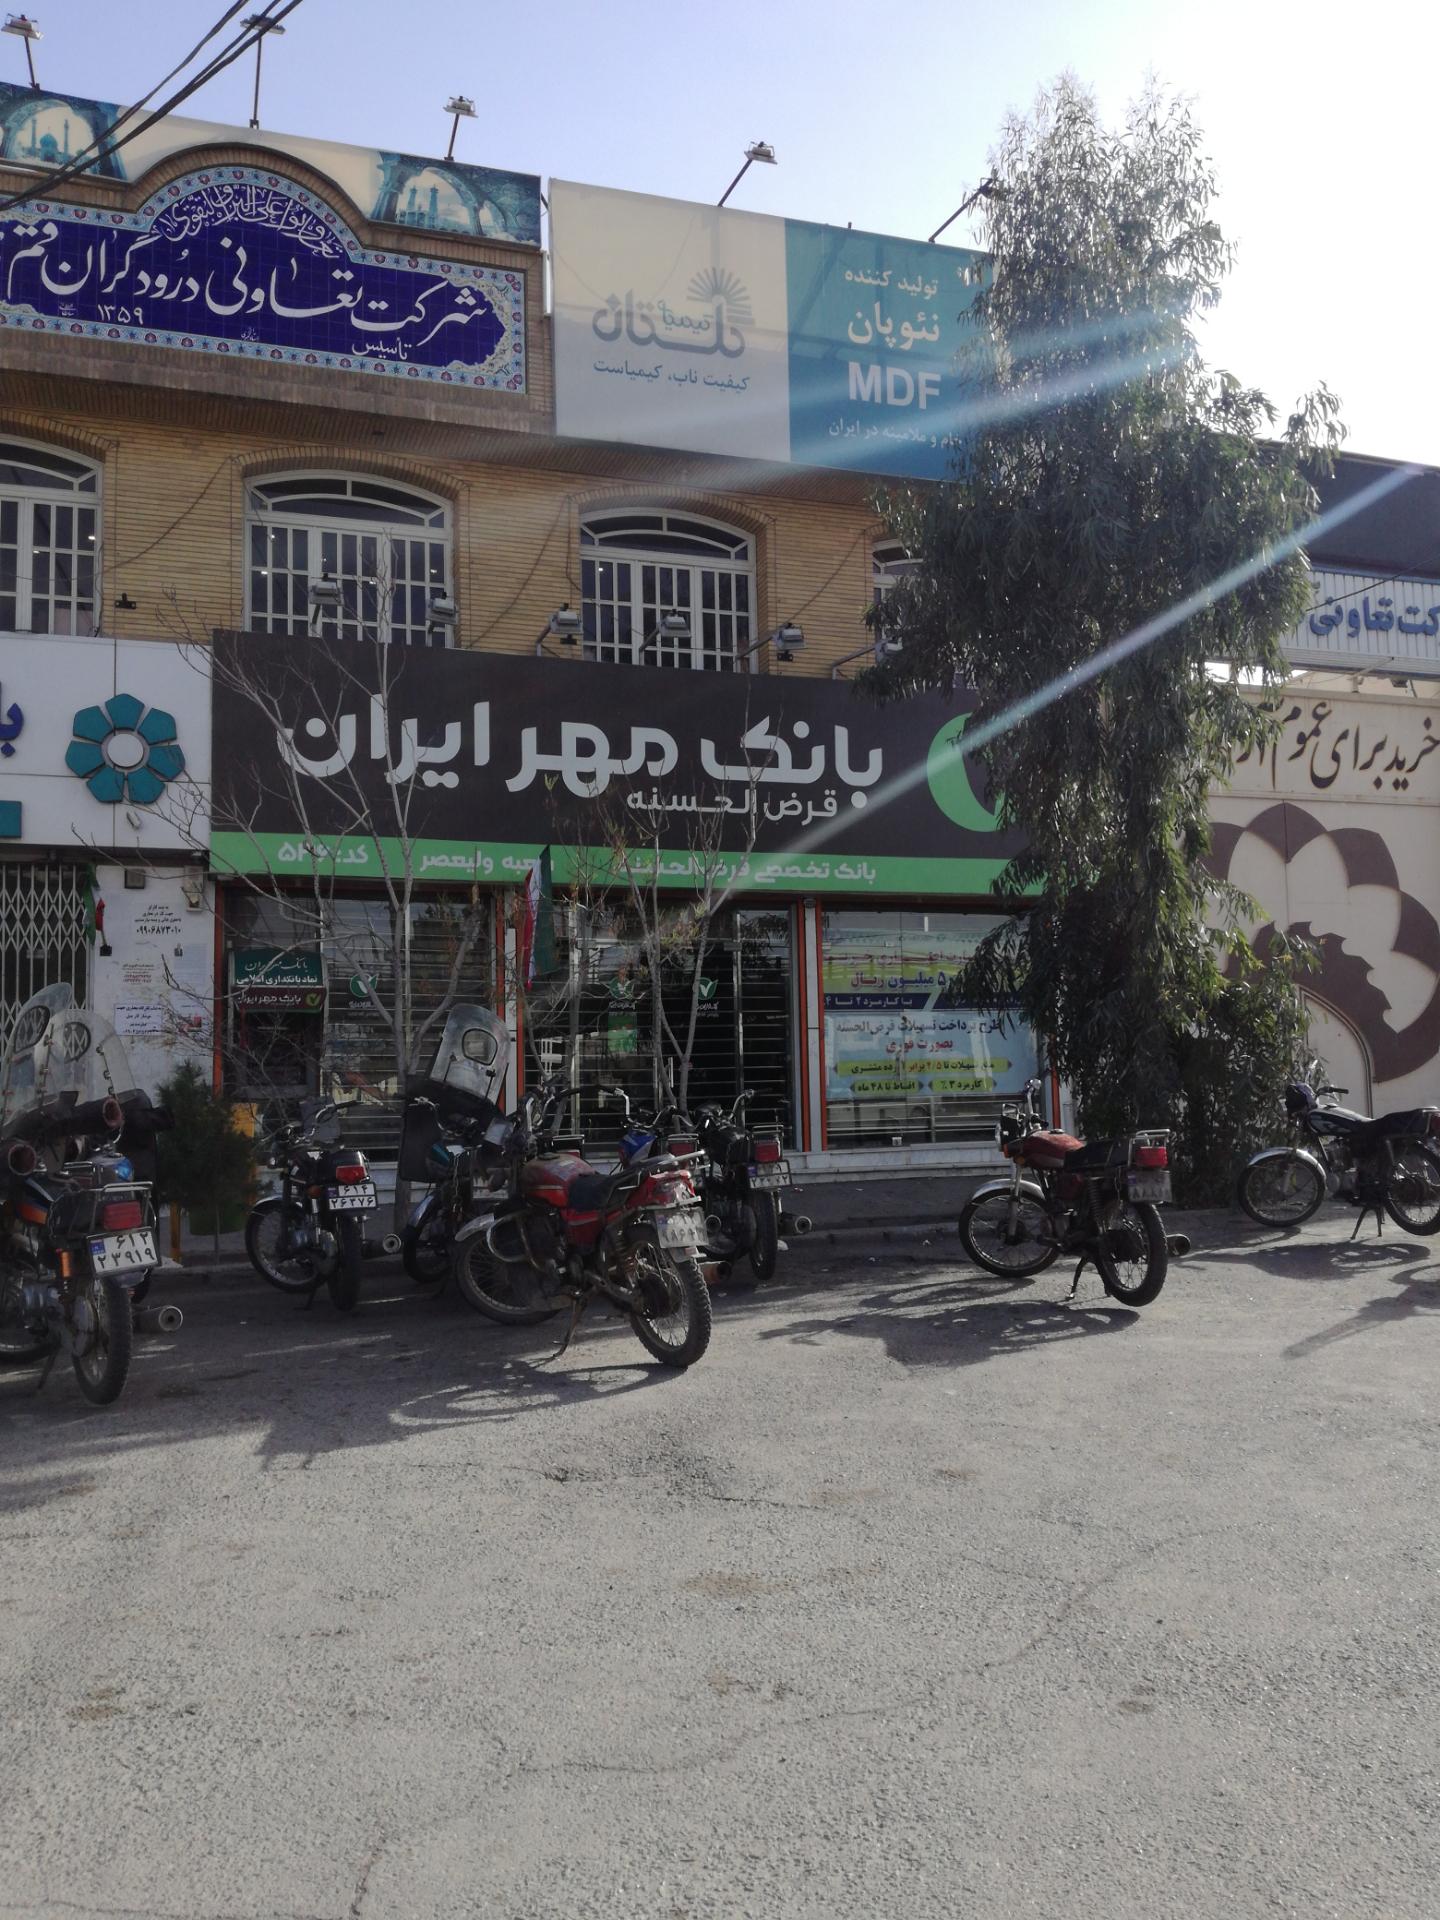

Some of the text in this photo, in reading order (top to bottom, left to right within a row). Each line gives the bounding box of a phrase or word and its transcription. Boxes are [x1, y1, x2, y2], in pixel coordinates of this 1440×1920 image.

[7, 221, 488, 347] شرکت تعاونی درودگران قم
[844, 269, 893, 287] کننده
[897, 275, 939, 300] تولید
[98, 303, 144, 325] ۱۳۵۹
[848, 301, 941, 350] نئوپان
[592, 359, 664, 383] کیمیاست
[702, 373, 751, 395] کیفیت
[848, 361, 942, 410] MDF
[828, 416, 861, 438] ایران
[864, 423, 880, 440] در
[1309, 596, 1395, 638] تعاونی
[277, 693, 883, 809] بانک مهر ایران
[1308, 723, 1388, 790] برای
[1382, 717, 1440, 791] خرید
[627, 786, 838, 826] قرض الحسنه
[419, 850, 494, 874] ولیعصر
[502, 855, 554, 872] عبه
[754, 860, 830, 883] تخصصی
[834, 861, 876, 885] بانک
[887, 971, 934, 991] میلیون
[863, 996, 900, 1008] کارمزد
[97, 1247, 155, 1270] ۲۳۹۱۹
